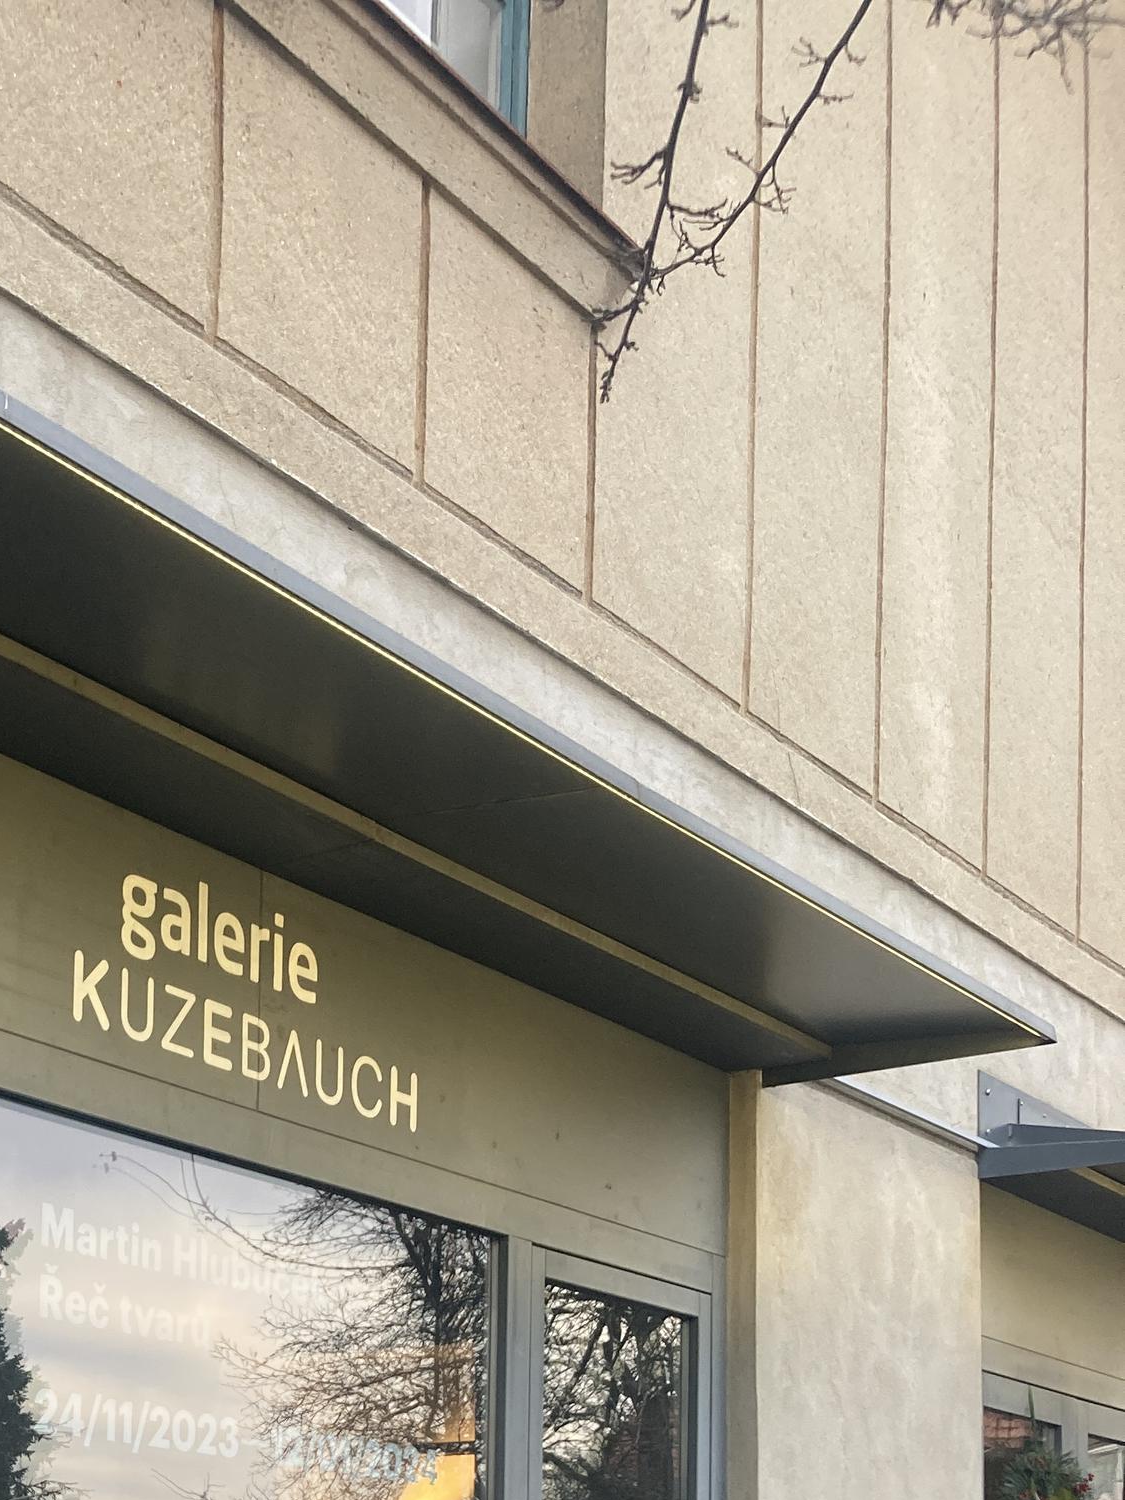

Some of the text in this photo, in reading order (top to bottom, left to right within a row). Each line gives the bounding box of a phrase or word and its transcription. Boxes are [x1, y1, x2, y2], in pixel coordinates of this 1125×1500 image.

[120, 873, 319, 1005] galerie
[72, 949, 418, 1133] KUZEBAUCH
[40, 1202, 163, 1273] Martin
[39, 1262, 110, 1329] Řeč
